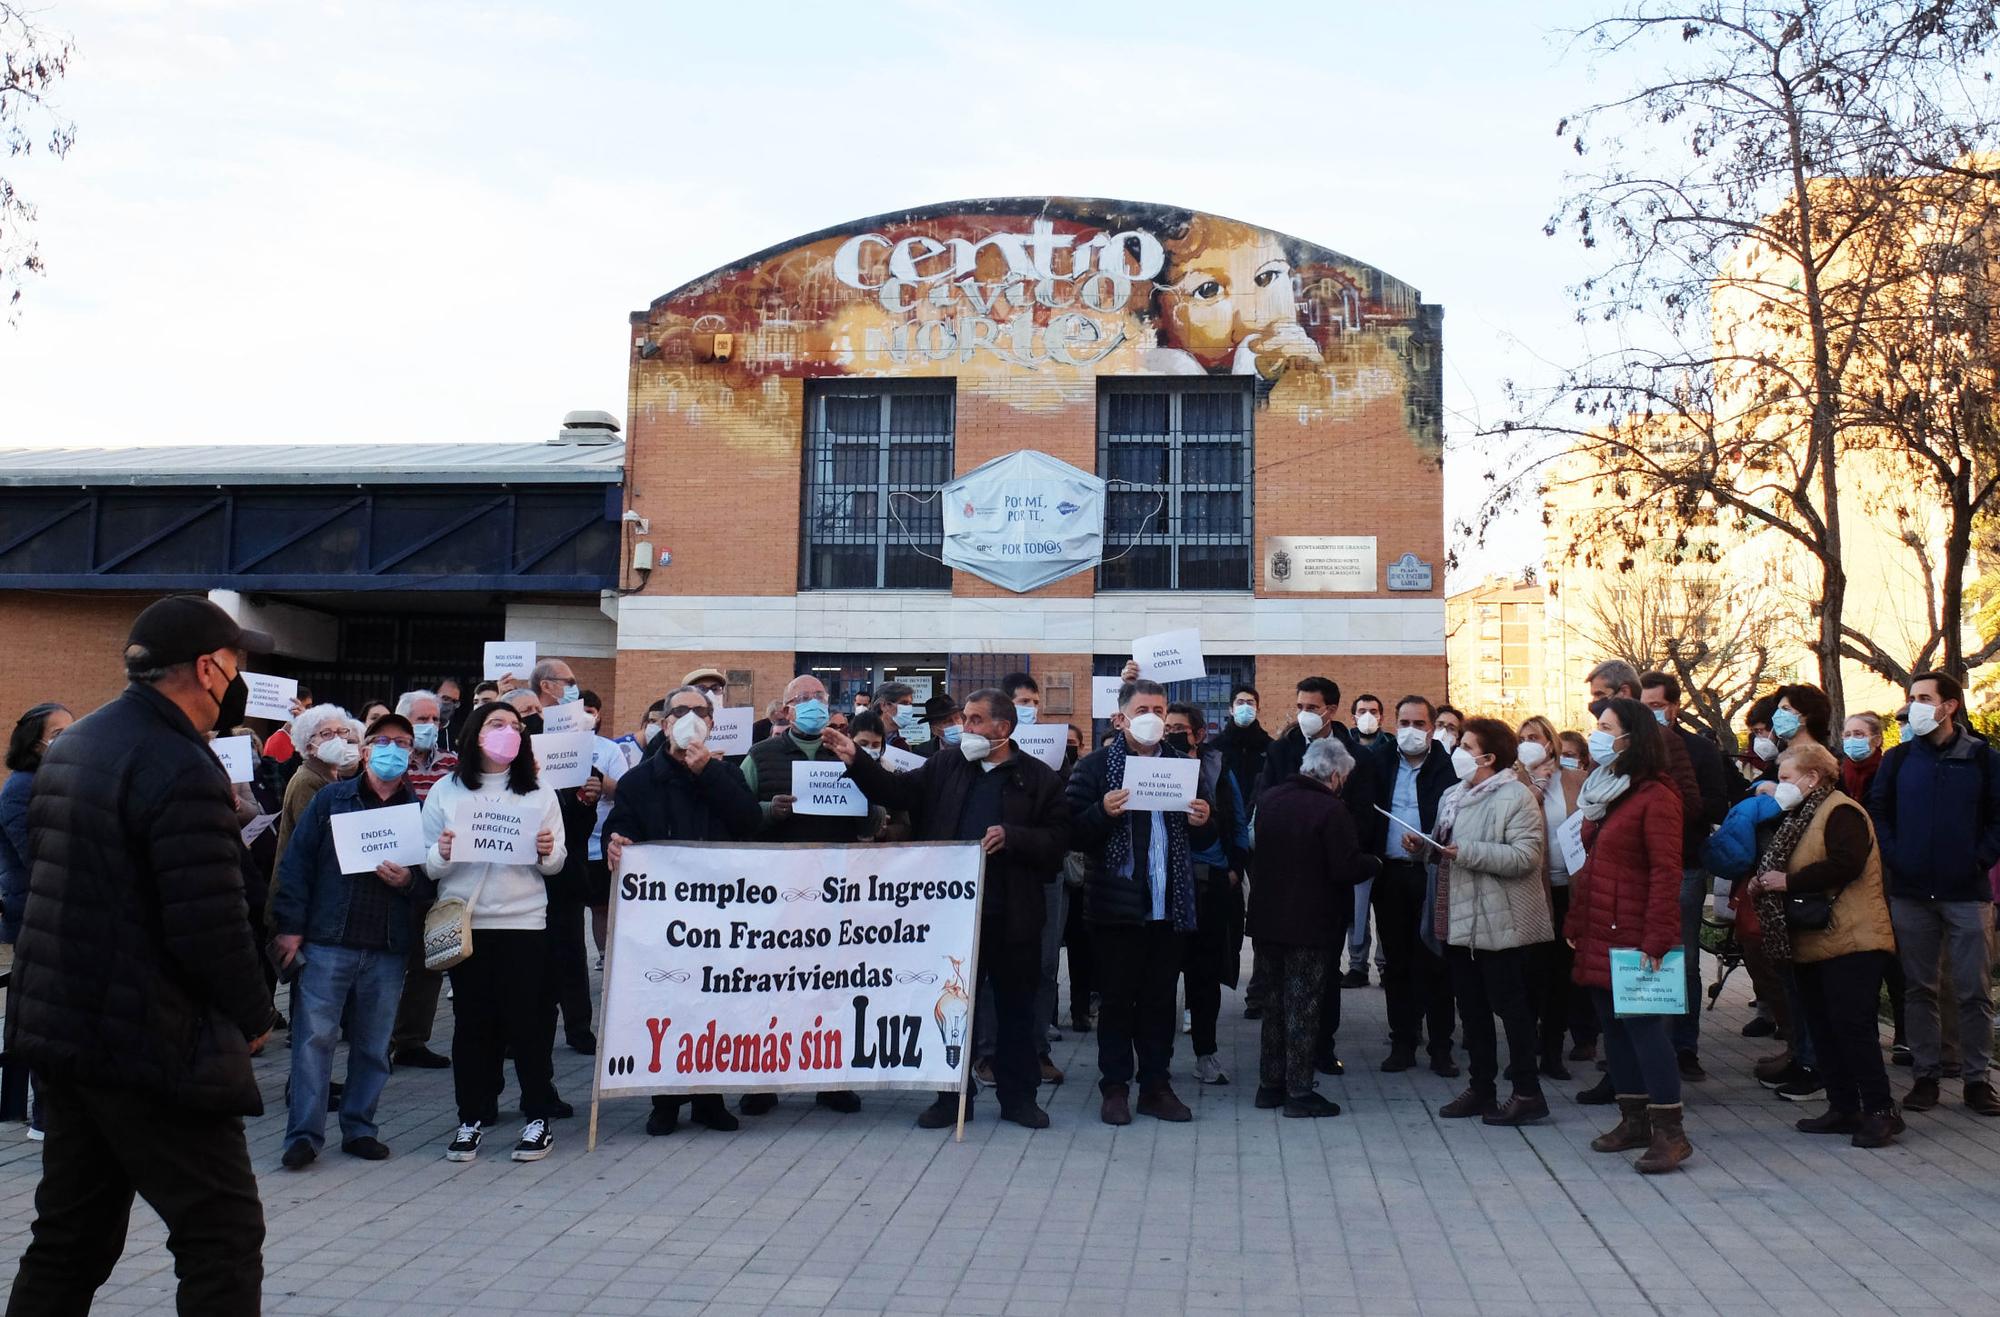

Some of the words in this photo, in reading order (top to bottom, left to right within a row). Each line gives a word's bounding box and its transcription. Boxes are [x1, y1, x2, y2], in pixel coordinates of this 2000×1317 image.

[1008, 510, 1025, 522] POR
[1002, 543, 1020, 555] POR
[1025, 540, 1062, 555] TOD@S
[560, 749, 578, 758] ESTÁN
[546, 762, 578, 770] APAGANDO
[809, 780, 852, 789] ENERGÉTICA
[812, 794, 848, 804] MATA
[485, 812, 521, 824] POBREZA
[360, 828, 396, 840] ENDESA,
[471, 823, 520, 836] ENERGÉTICA
[361, 840, 399, 853] CÓRTATE
[474, 838, 514, 852] MATA
[621, 873, 666, 902] Sin
[674, 878, 778, 909] empleo
[822, 876, 860, 903] Sin
[868, 875, 976, 907] Ingresos
[666, 919, 721, 948] Con
[730, 921, 831, 949] Fracaso
[838, 918, 930, 947] Escolar
[700, 962, 893, 993] Infraviviendas
[646, 1017, 672, 1073] Y
[676, 1016, 792, 1074] además
[799, 1015, 842, 1070] sin
[851, 995, 922, 1070] Luz
